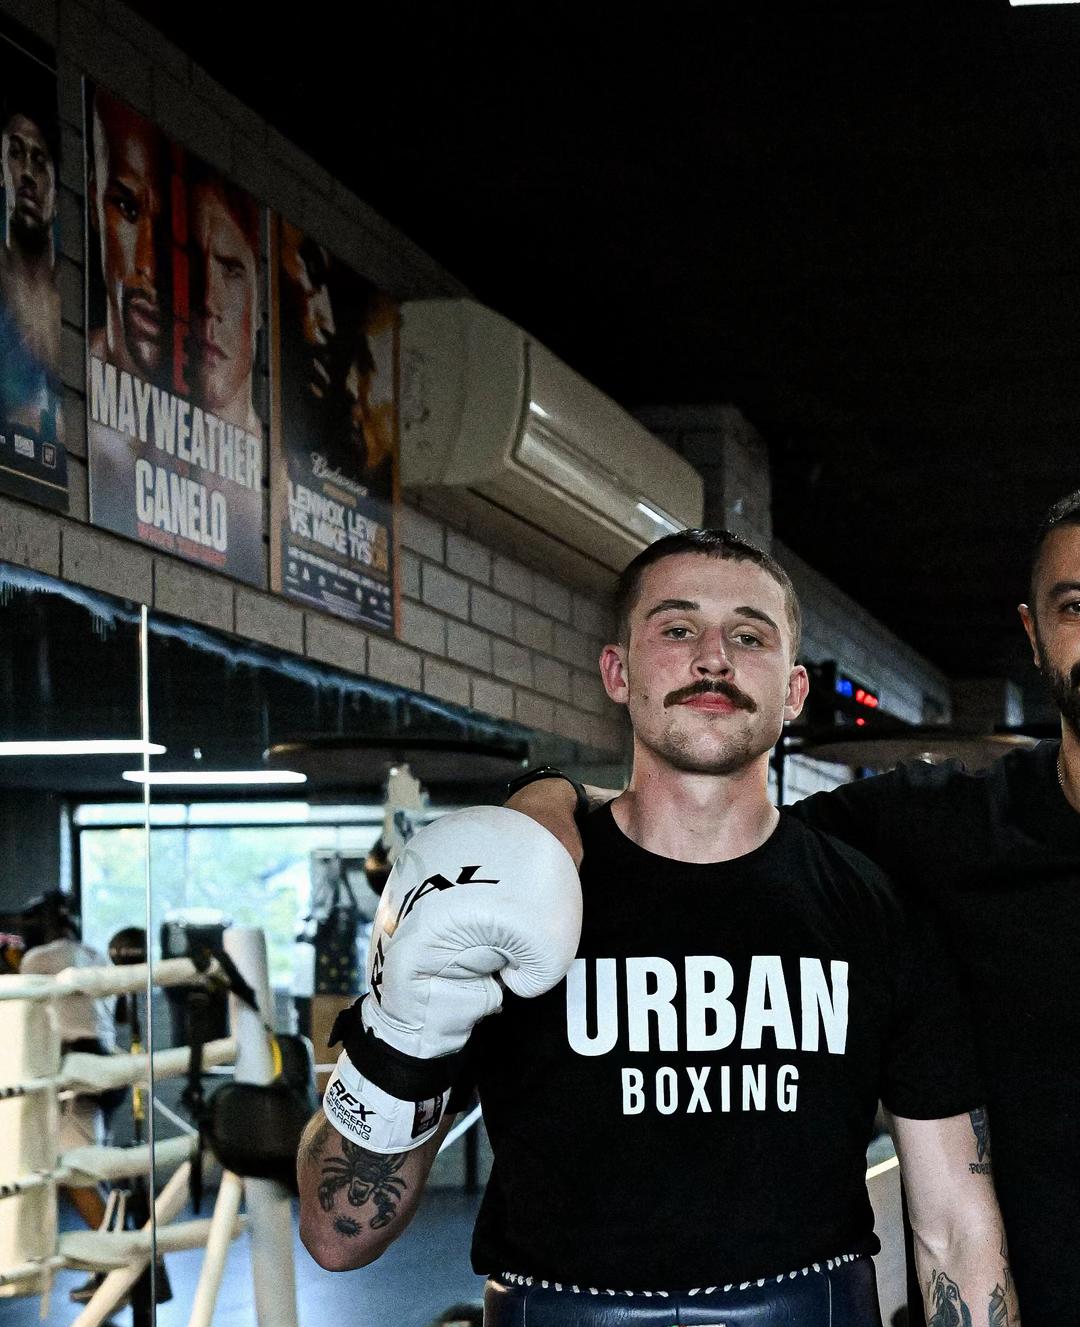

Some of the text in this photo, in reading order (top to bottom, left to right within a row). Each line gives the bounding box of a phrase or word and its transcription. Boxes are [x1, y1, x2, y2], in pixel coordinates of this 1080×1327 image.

[91, 355, 262, 492] MAYWEATHER
[136, 458, 227, 552] CANELO
[566, 955, 849, 1057] URBAN
[329, 1086, 372, 1133] GUERRERO
[332, 1078, 377, 1122] RFX
[621, 1064, 800, 1116] BOXING
